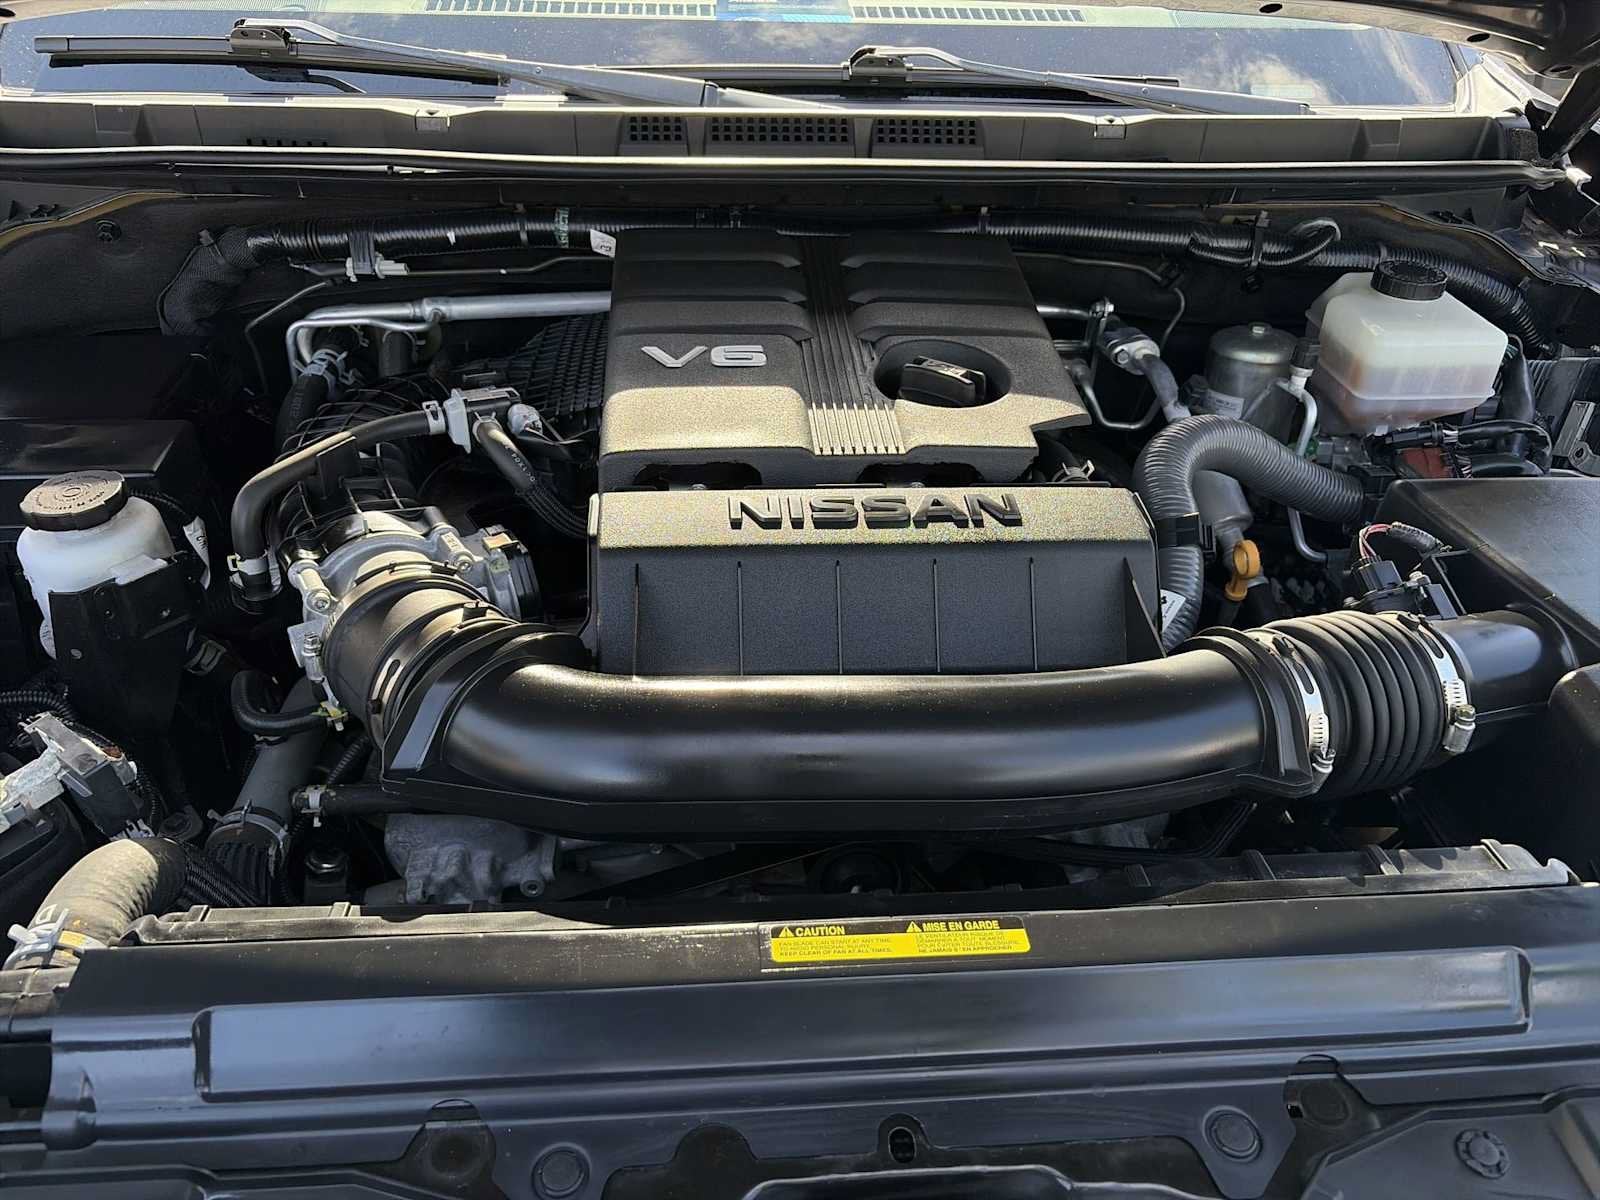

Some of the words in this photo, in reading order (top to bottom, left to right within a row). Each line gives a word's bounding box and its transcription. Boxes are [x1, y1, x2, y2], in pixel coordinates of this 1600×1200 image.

[641, 345, 767, 367] V6
[728, 494, 1022, 530] NISSAN
[795, 925, 846, 937] CAUTION
[922, 921, 948, 932] MISE
[948, 920, 963, 931] EN
[963, 919, 1000, 931] GARDE
